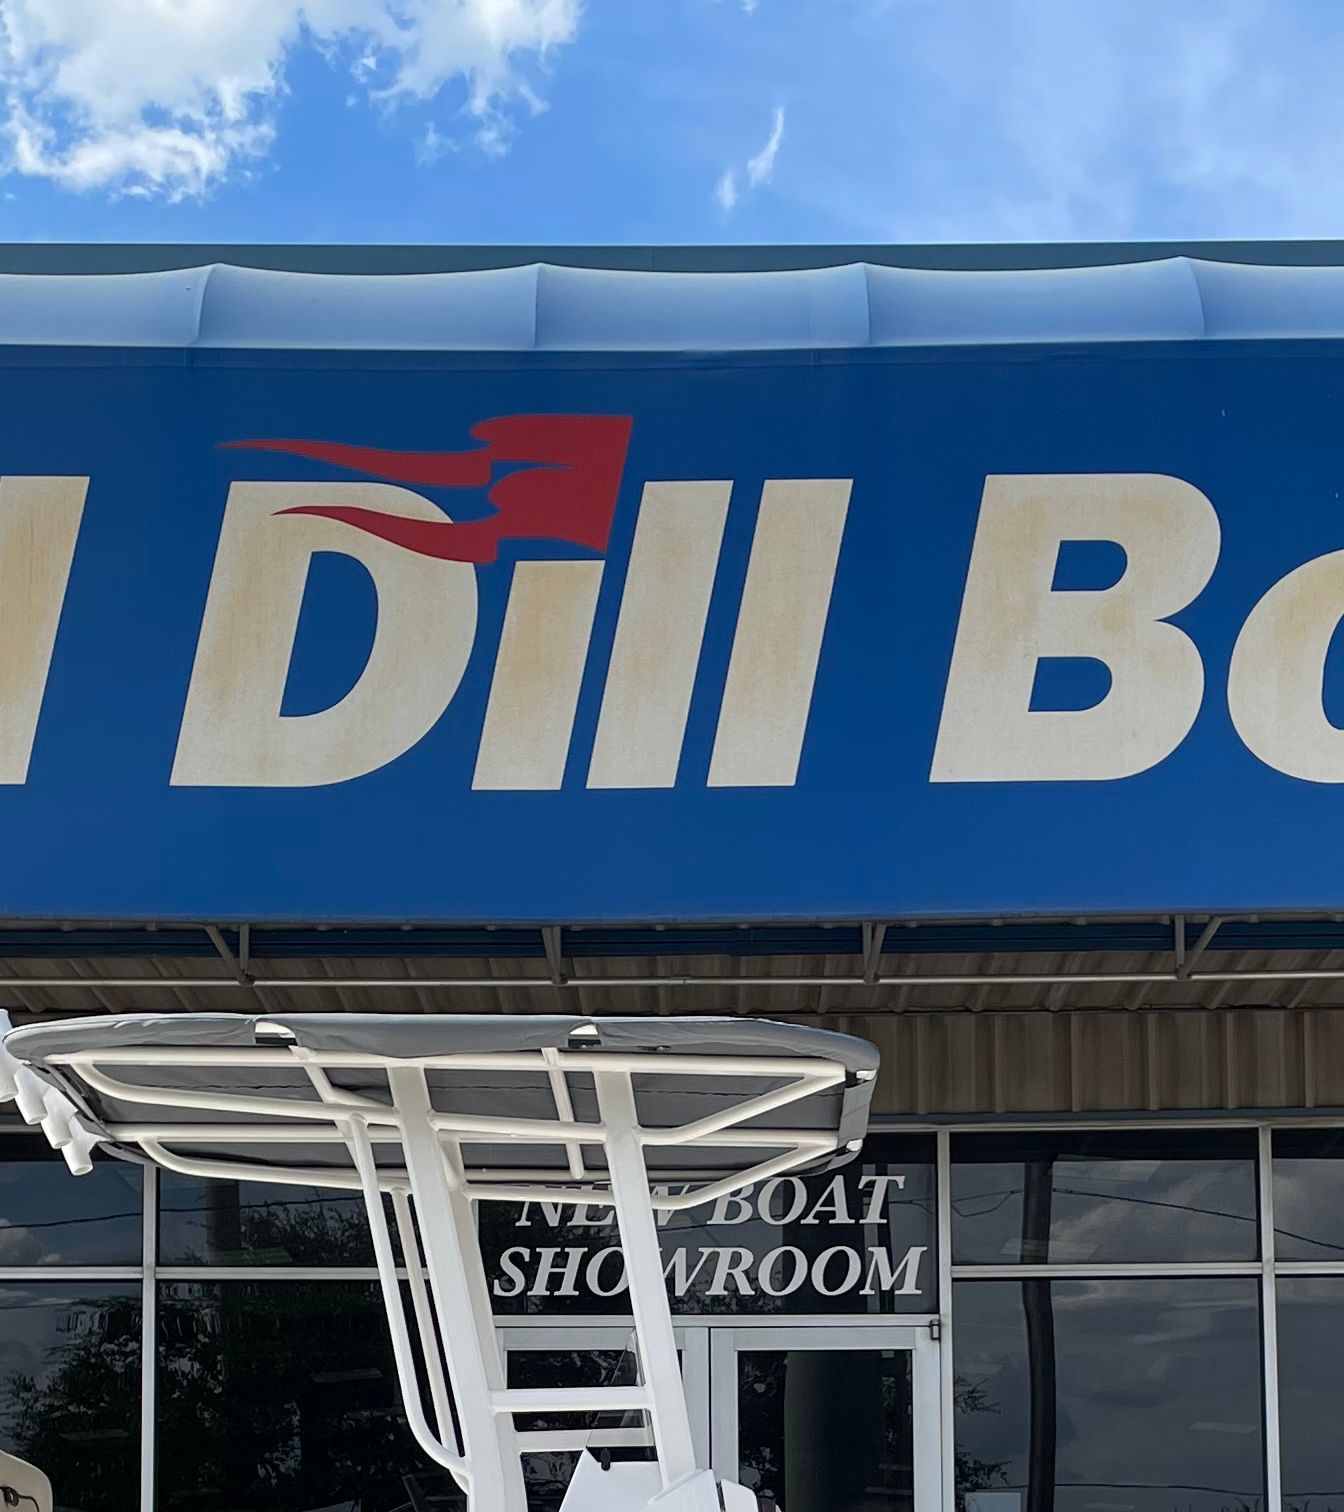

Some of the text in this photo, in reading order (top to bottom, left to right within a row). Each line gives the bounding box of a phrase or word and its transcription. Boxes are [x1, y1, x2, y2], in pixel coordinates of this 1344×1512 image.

[169, 479, 854, 791] Dill
[706, 1174, 906, 1226] BOAT
[492, 1245, 928, 1297] SHOWROOM
